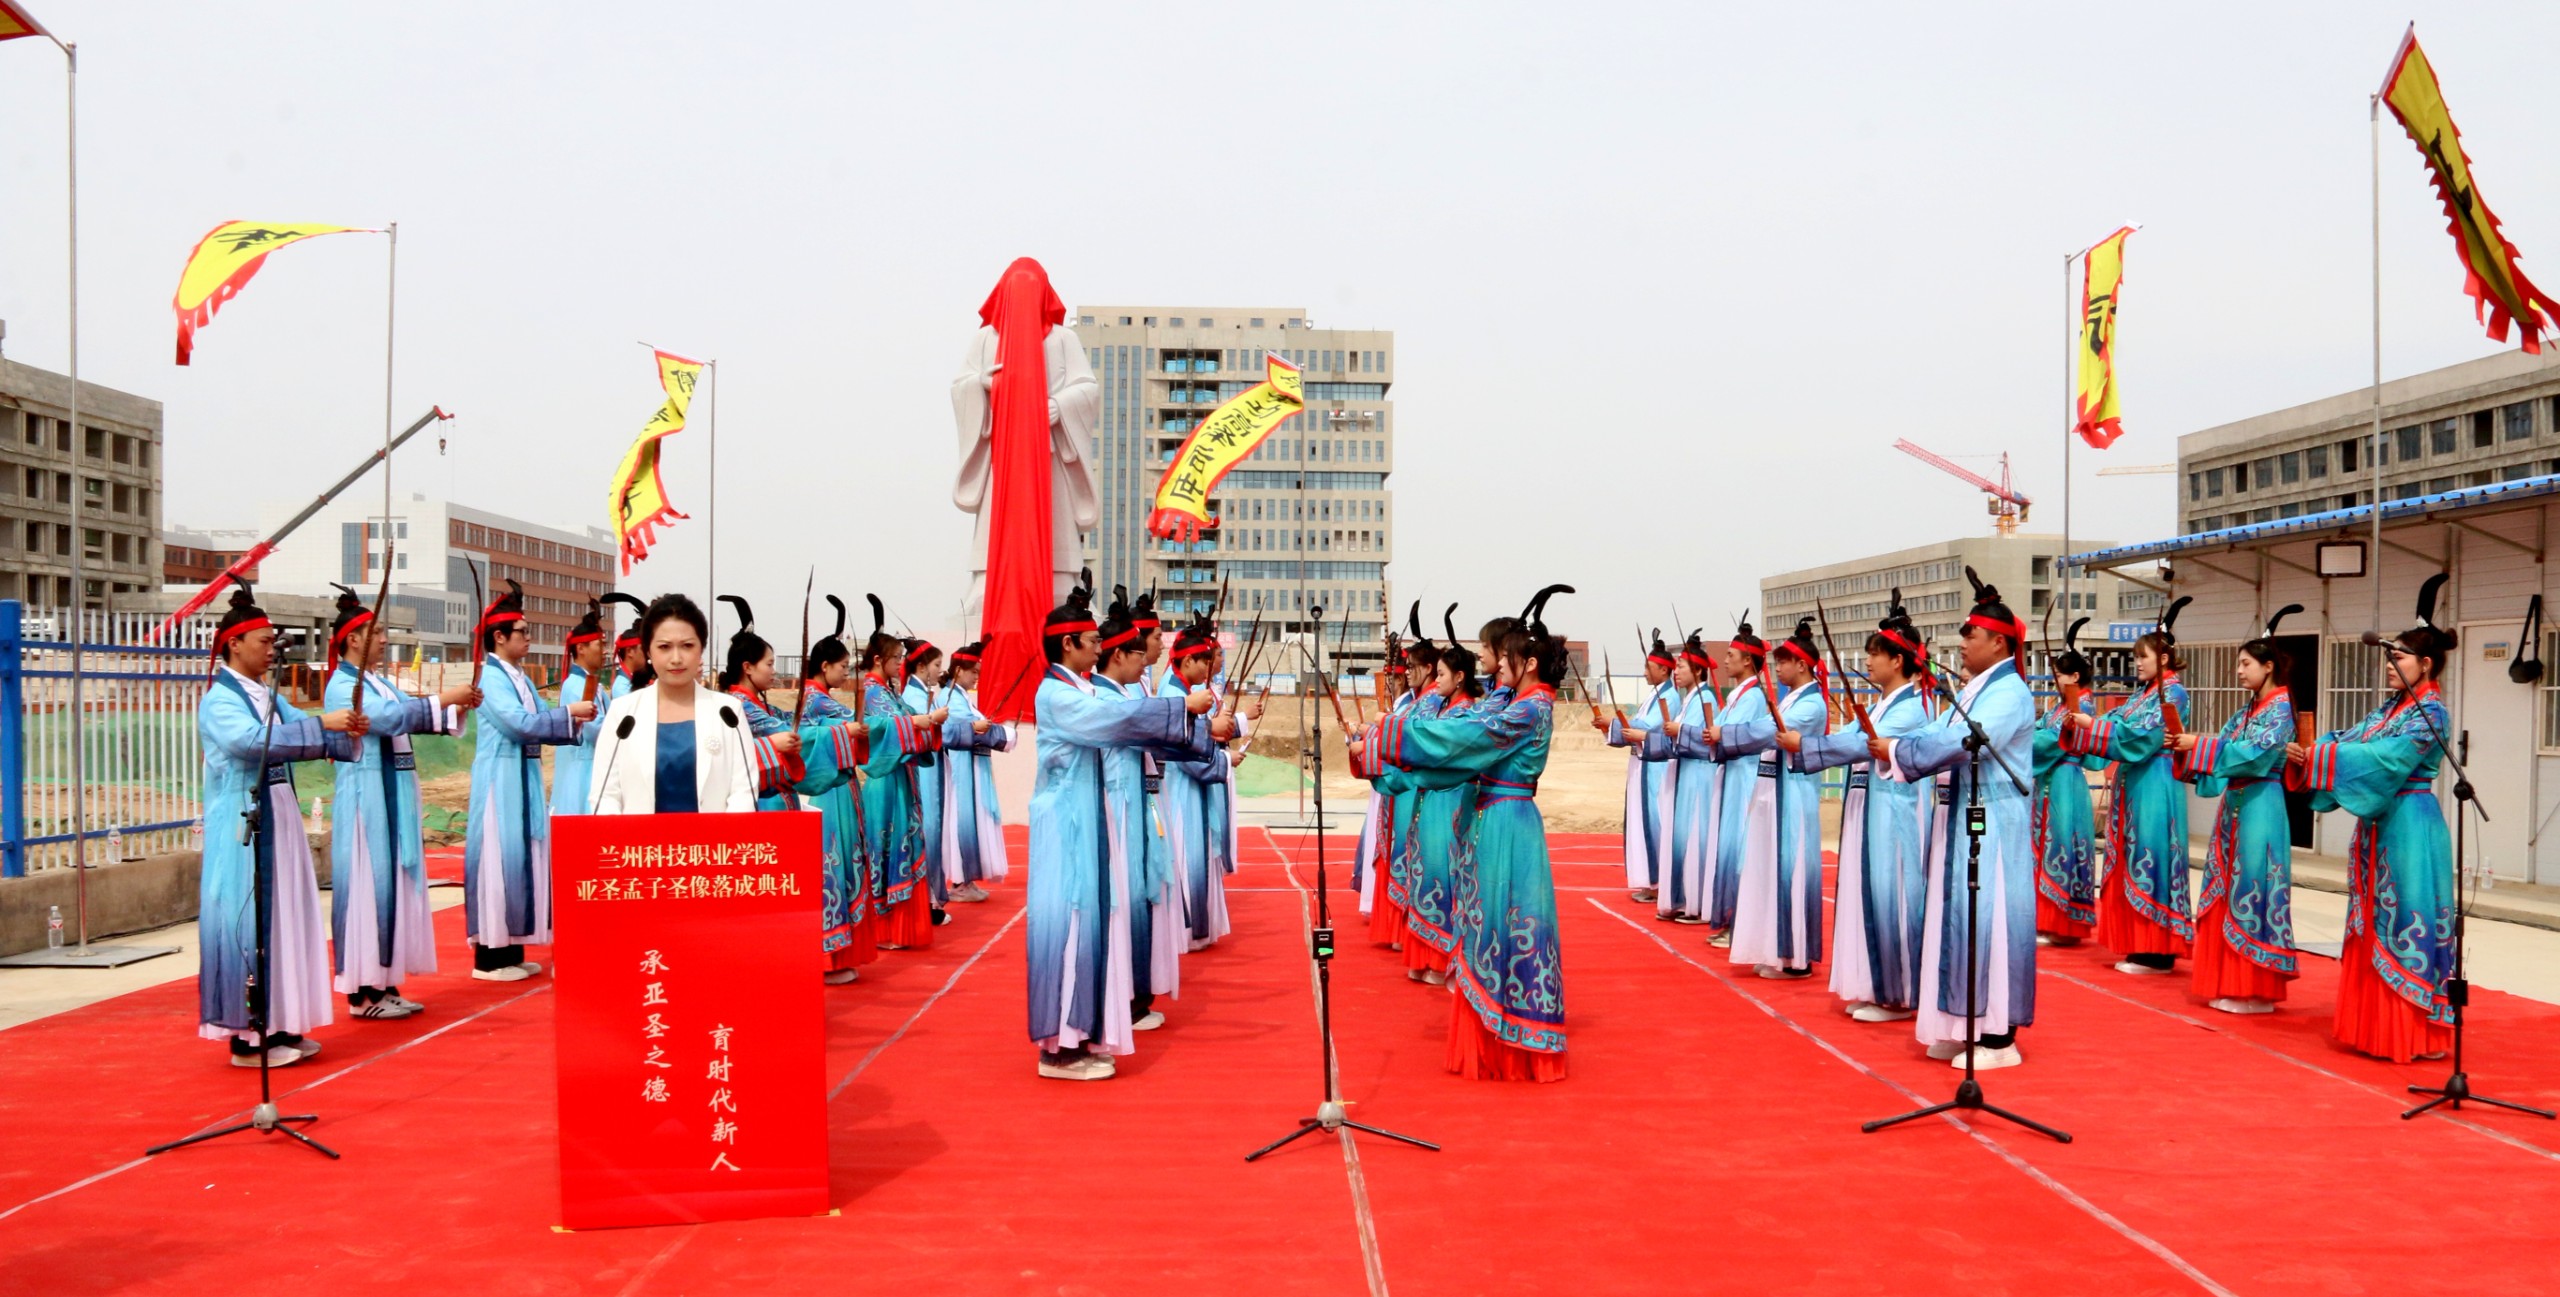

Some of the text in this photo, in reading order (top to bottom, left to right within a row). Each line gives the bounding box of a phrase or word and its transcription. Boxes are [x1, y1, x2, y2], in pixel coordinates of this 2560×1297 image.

[576, 873, 801, 901] 亚圣孟子圣像落成典礼
[598, 842, 778, 869] 兰州科技职业学院
[639, 949, 672, 1103] 承亚圣之德
[706, 1023, 741, 1172] 育时代新人
